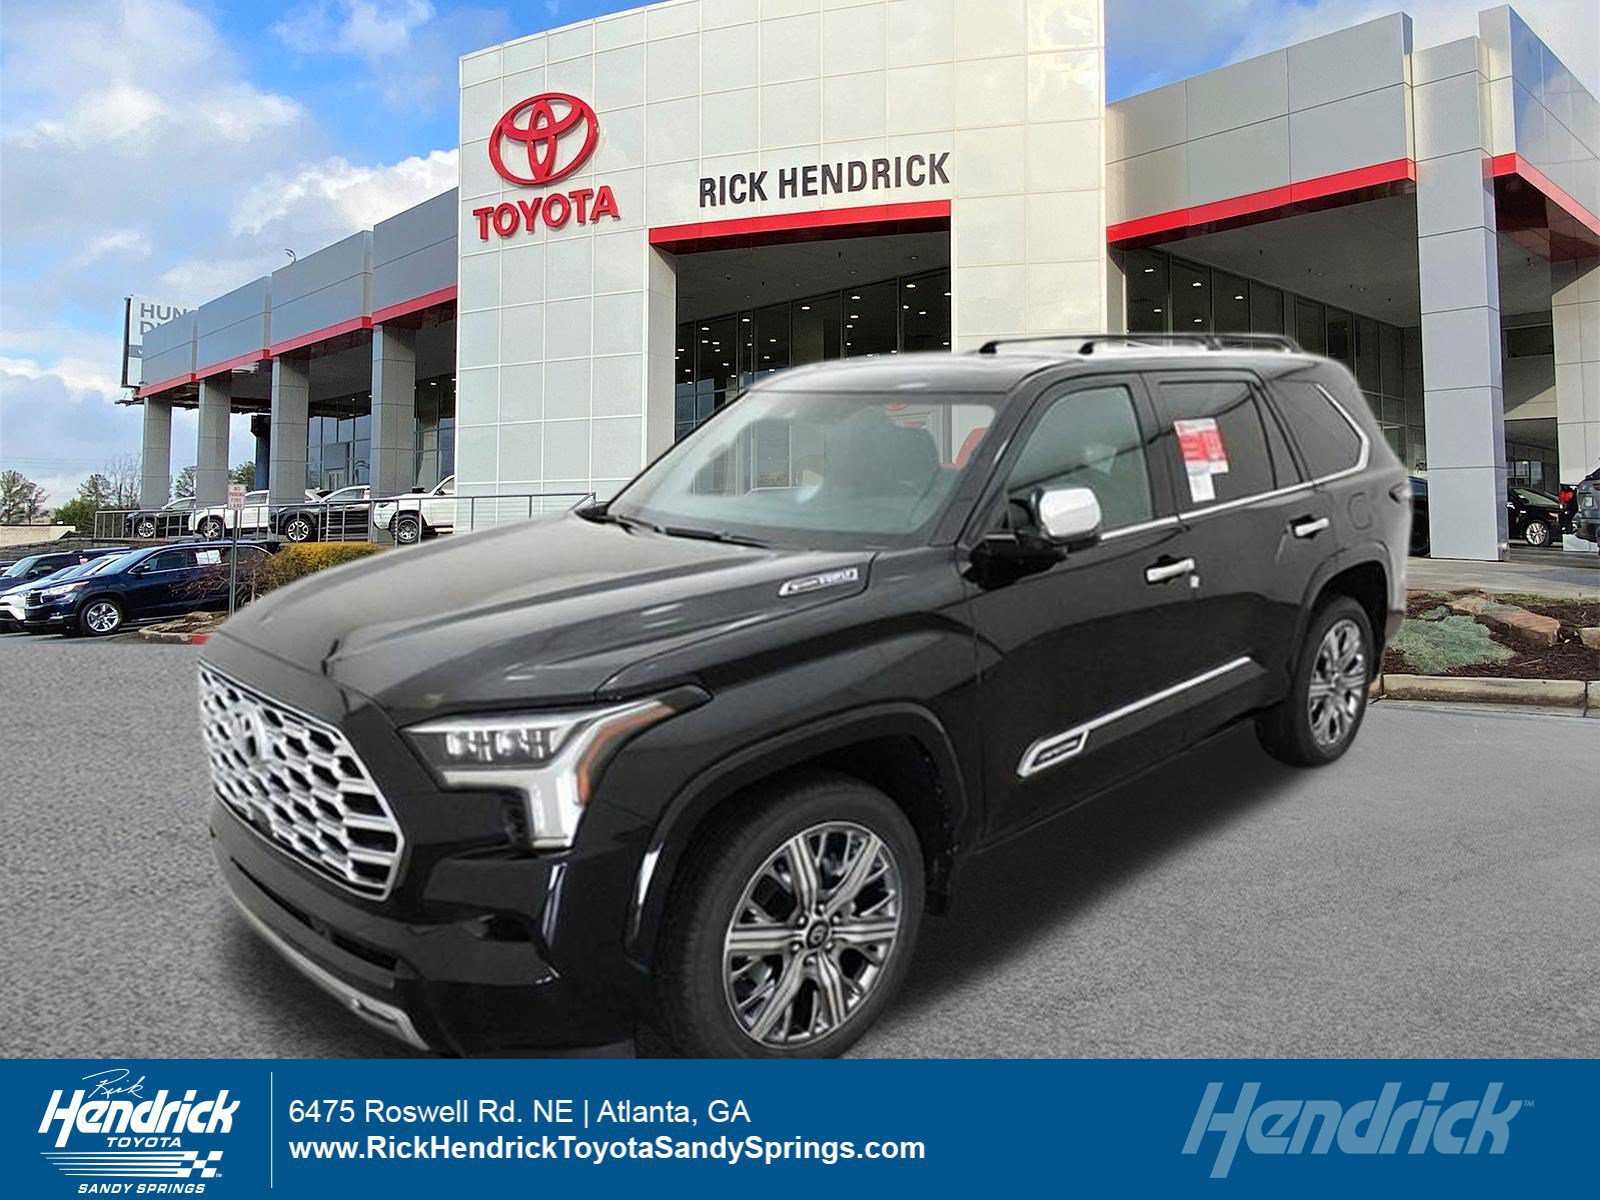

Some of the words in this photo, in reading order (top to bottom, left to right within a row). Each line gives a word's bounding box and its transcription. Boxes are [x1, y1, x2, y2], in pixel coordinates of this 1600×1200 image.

[699, 170, 768, 208] RICK
[778, 152, 950, 199] HENDRICK
[472, 185, 621, 241] TOYOTA
